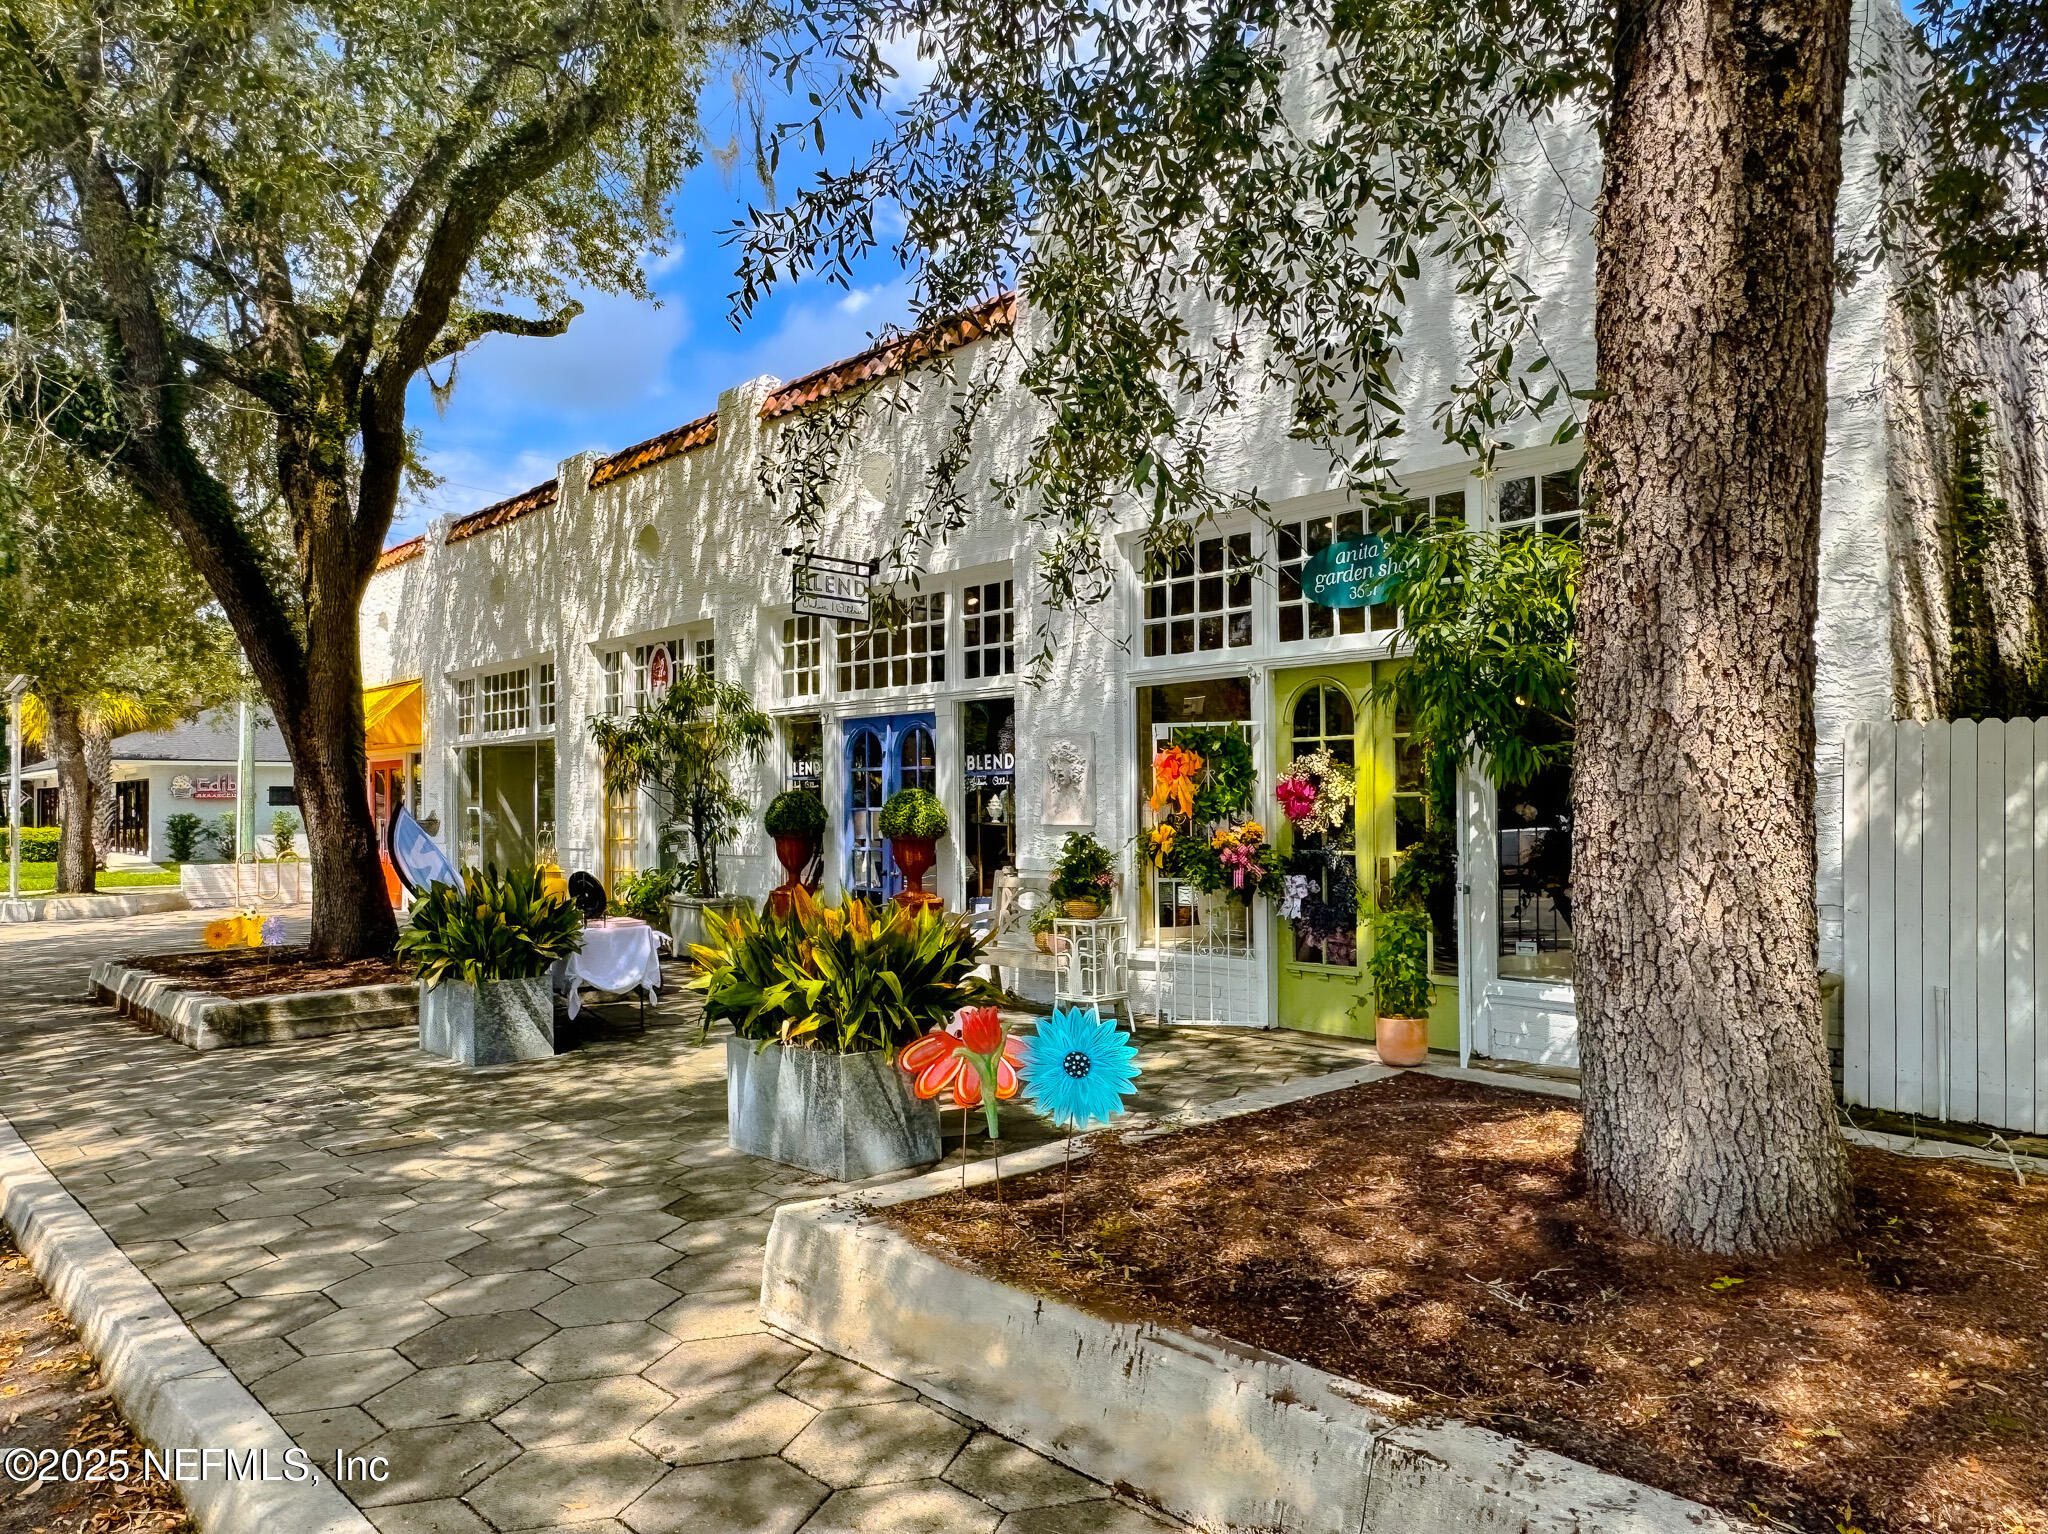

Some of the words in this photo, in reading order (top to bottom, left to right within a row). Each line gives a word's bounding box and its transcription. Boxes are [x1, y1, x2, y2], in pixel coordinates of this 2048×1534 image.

[1336, 537, 1391, 564] anita's
[1314, 563, 1375, 594] garden
[792, 760, 822, 777] LEND
[966, 752, 1015, 771] BLEND
[196, 773, 237, 792] Edib
